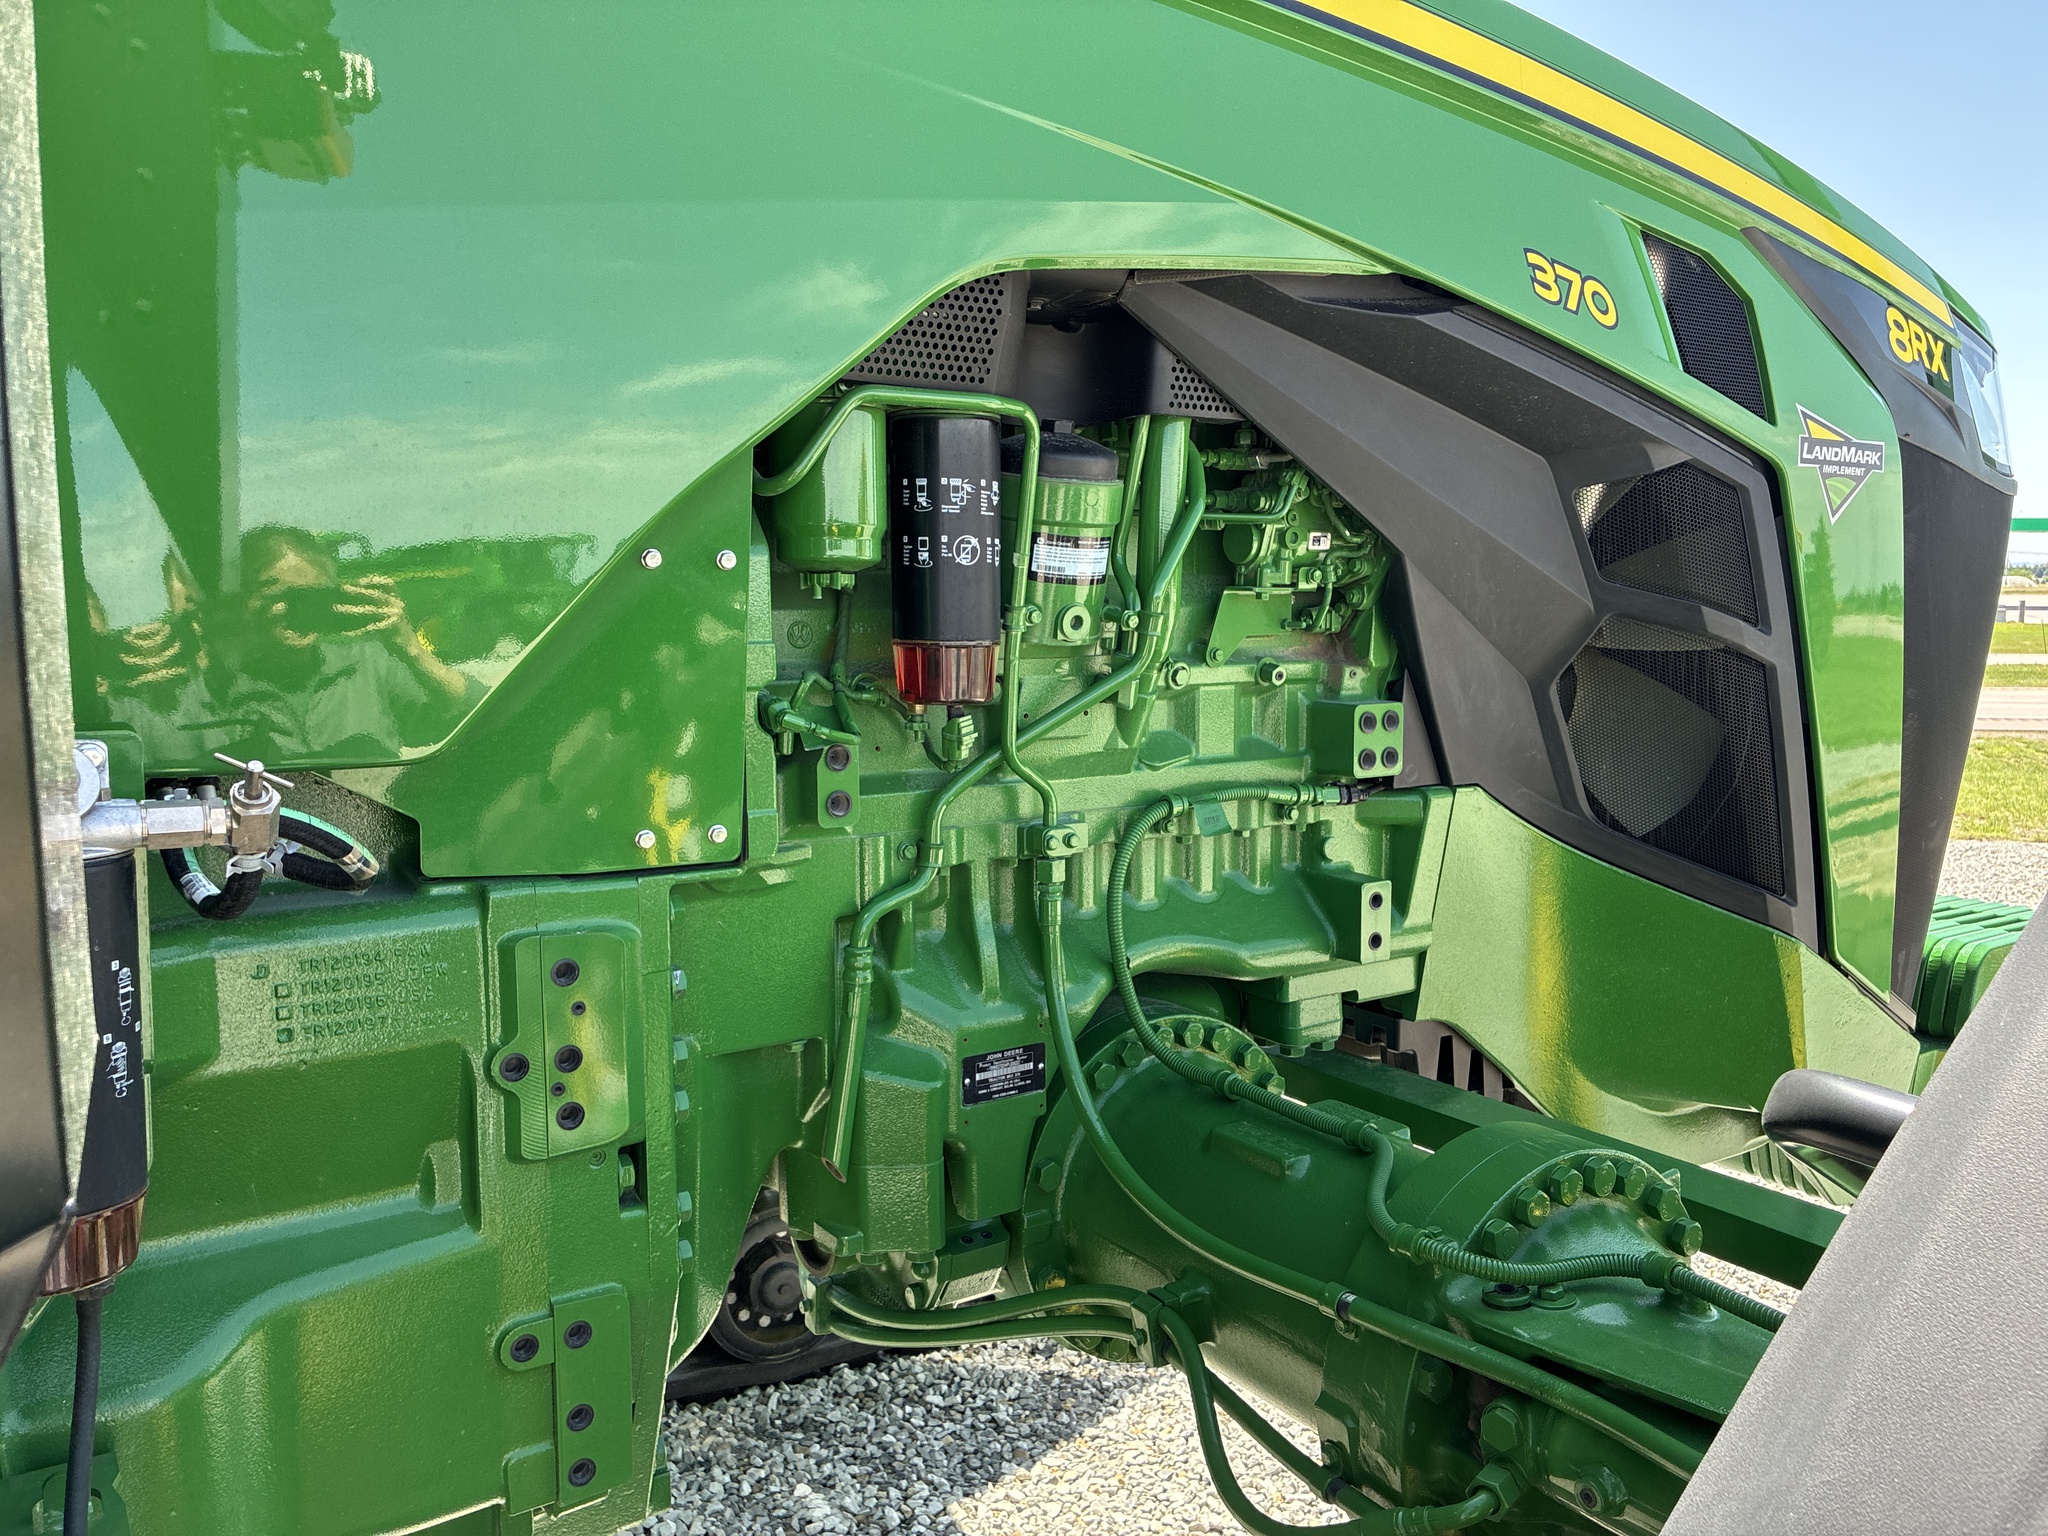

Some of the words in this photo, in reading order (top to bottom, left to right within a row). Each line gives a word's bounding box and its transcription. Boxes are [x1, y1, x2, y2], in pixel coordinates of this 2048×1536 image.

[1523, 247, 1619, 331] 370
[1886, 307, 1949, 382] 8RX
[1822, 464, 1865, 476] IMPLEMENT
[986, 1052, 1002, 1061] JOHN
[1003, 1048, 1024, 1057] DEERE
